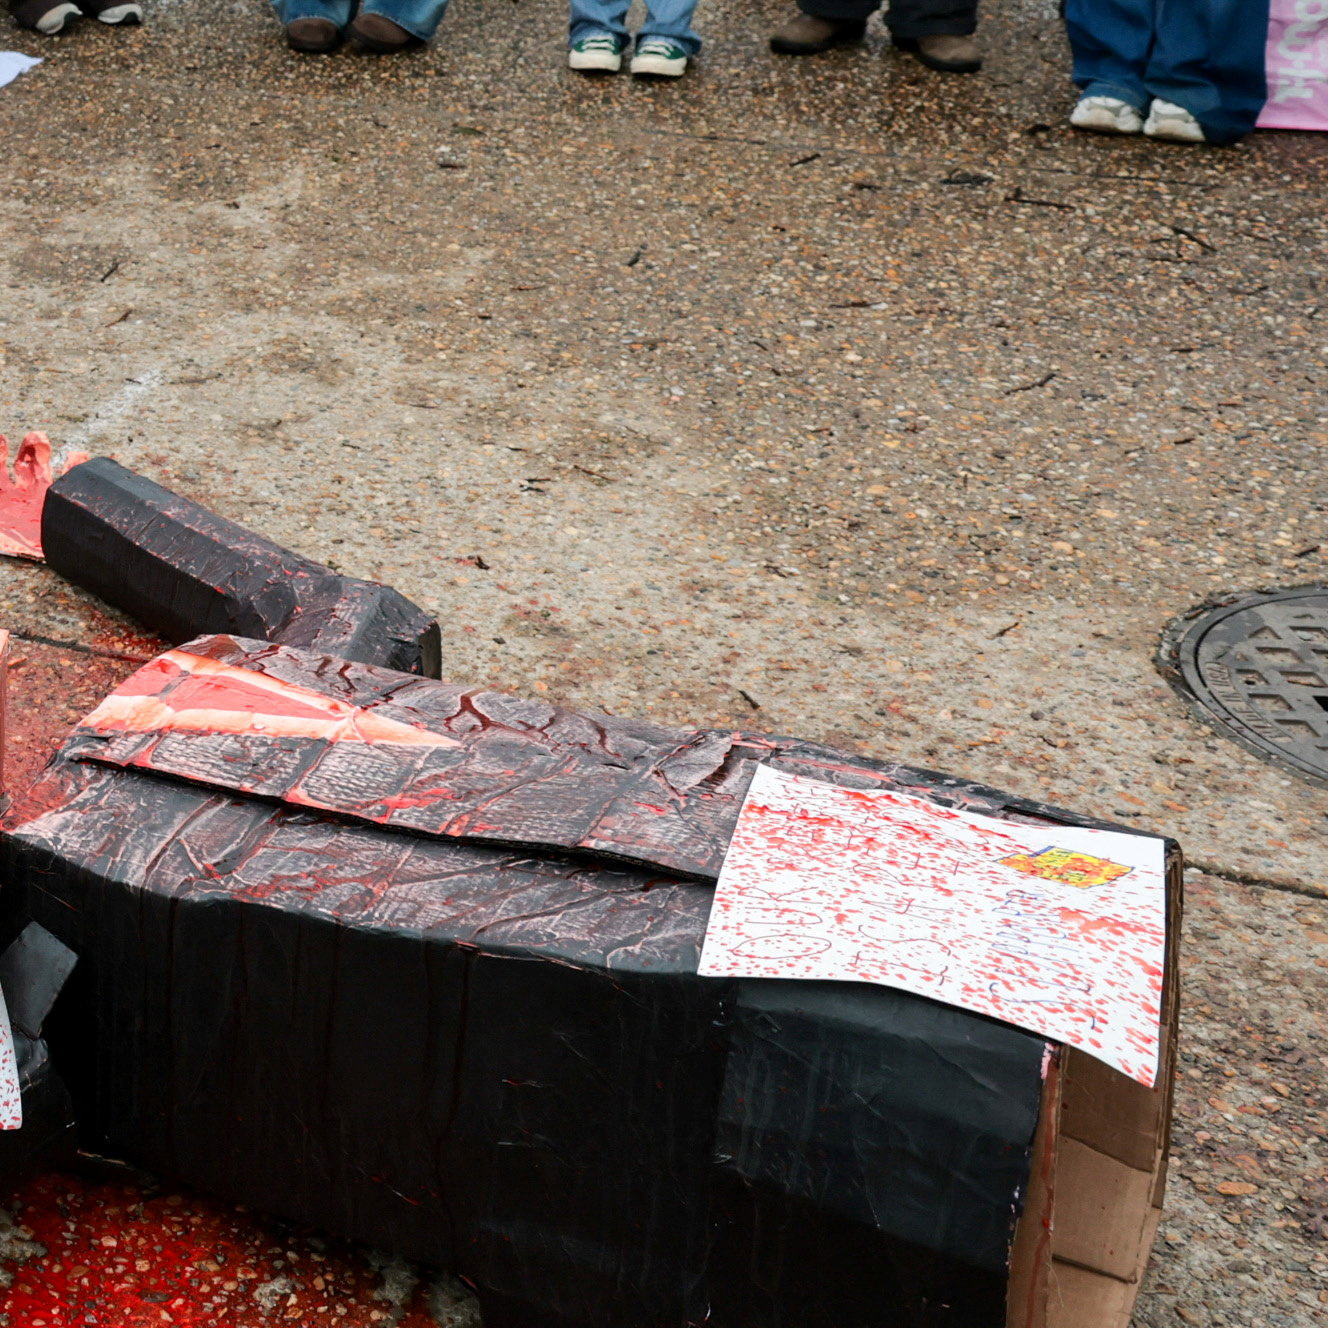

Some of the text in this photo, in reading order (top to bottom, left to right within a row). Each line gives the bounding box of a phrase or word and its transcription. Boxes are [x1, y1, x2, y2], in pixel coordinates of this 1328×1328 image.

[730, 885, 833, 960] OUR
[858, 897, 958, 929] A
[853, 924, 955, 987] IS
